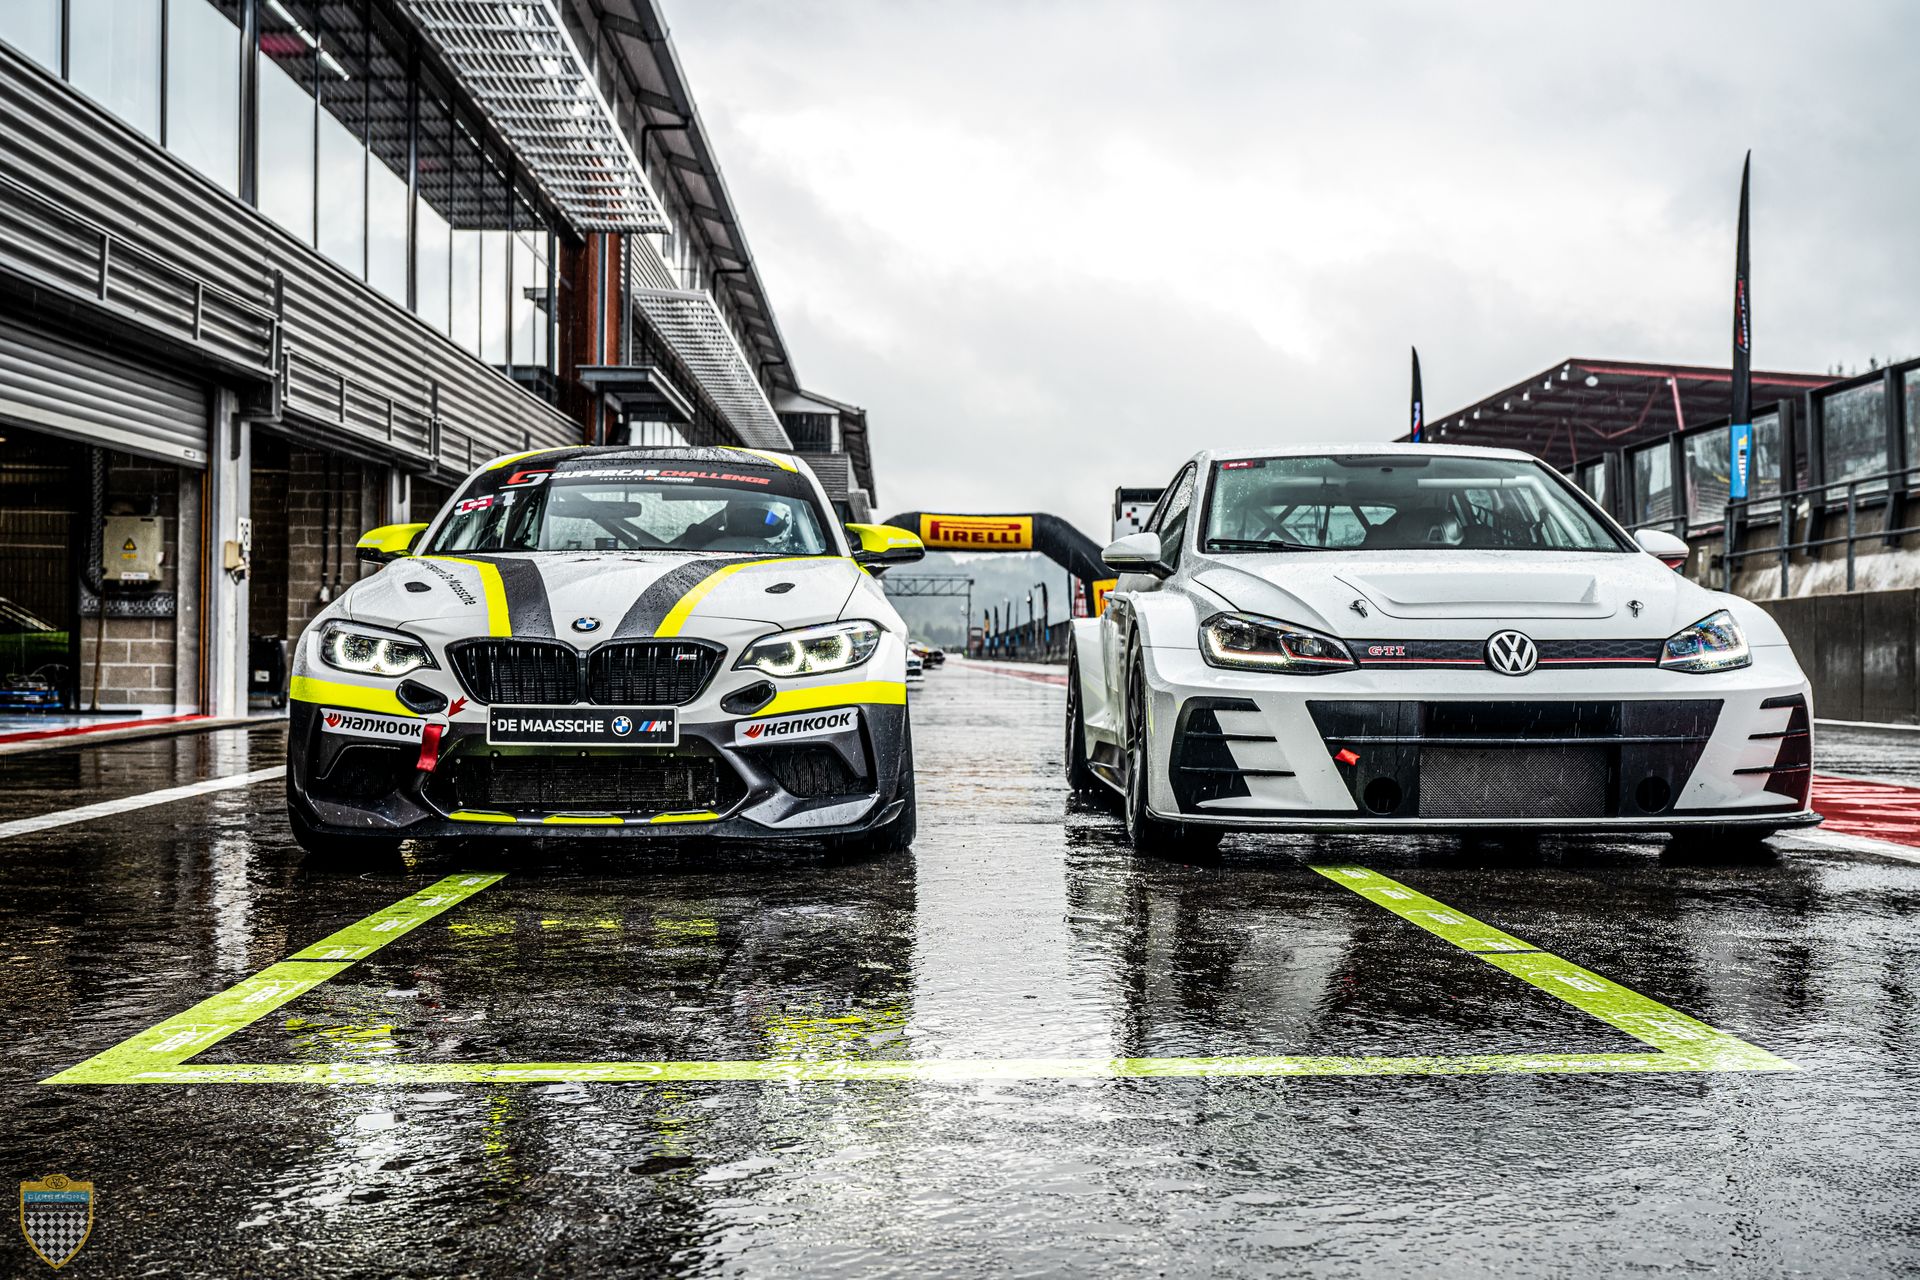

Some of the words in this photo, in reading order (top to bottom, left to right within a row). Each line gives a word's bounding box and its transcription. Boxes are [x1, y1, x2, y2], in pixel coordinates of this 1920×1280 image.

[549, 469, 660, 480] SUPERCAR
[659, 470, 771, 485] CHALLENGE
[930, 520, 1022, 544] PIRELLI
[1368, 645, 1406, 657] GTI
[497, 719, 517, 732] DE
[520, 719, 604, 733] MAASSCHE
